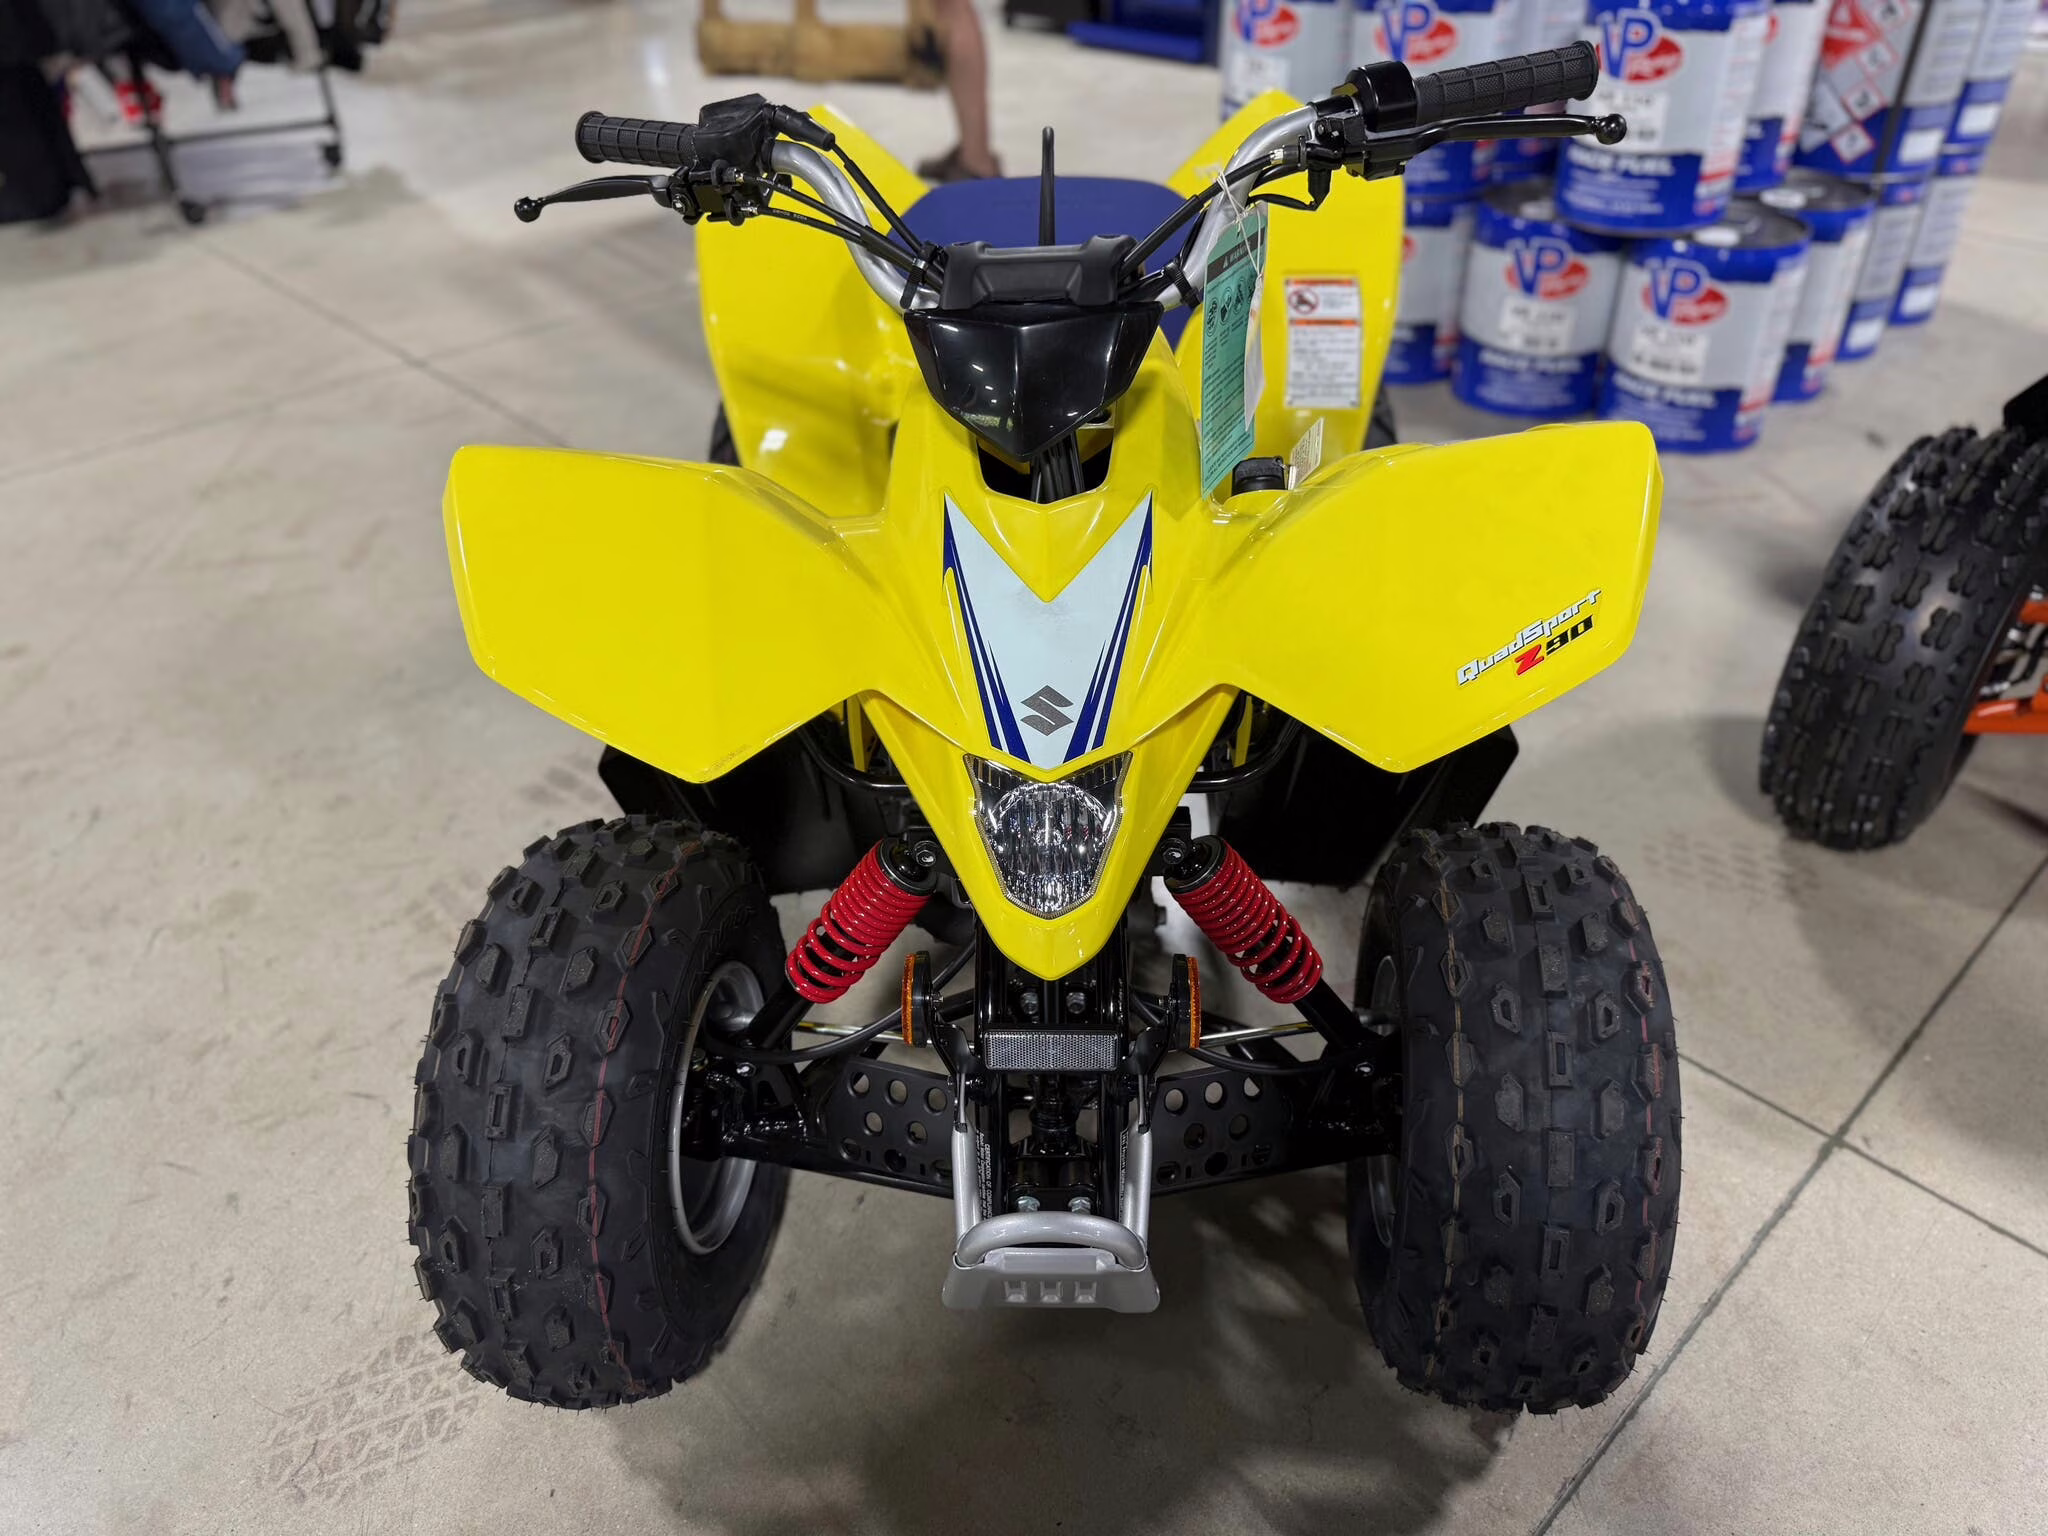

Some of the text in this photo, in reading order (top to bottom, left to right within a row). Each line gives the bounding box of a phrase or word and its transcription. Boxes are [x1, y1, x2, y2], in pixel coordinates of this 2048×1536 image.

[1380, 2, 1433, 64] VP
[1599, 13, 1658, 80] VP
[1511, 242, 1568, 296] VP
[1649, 263, 1703, 319] VP
